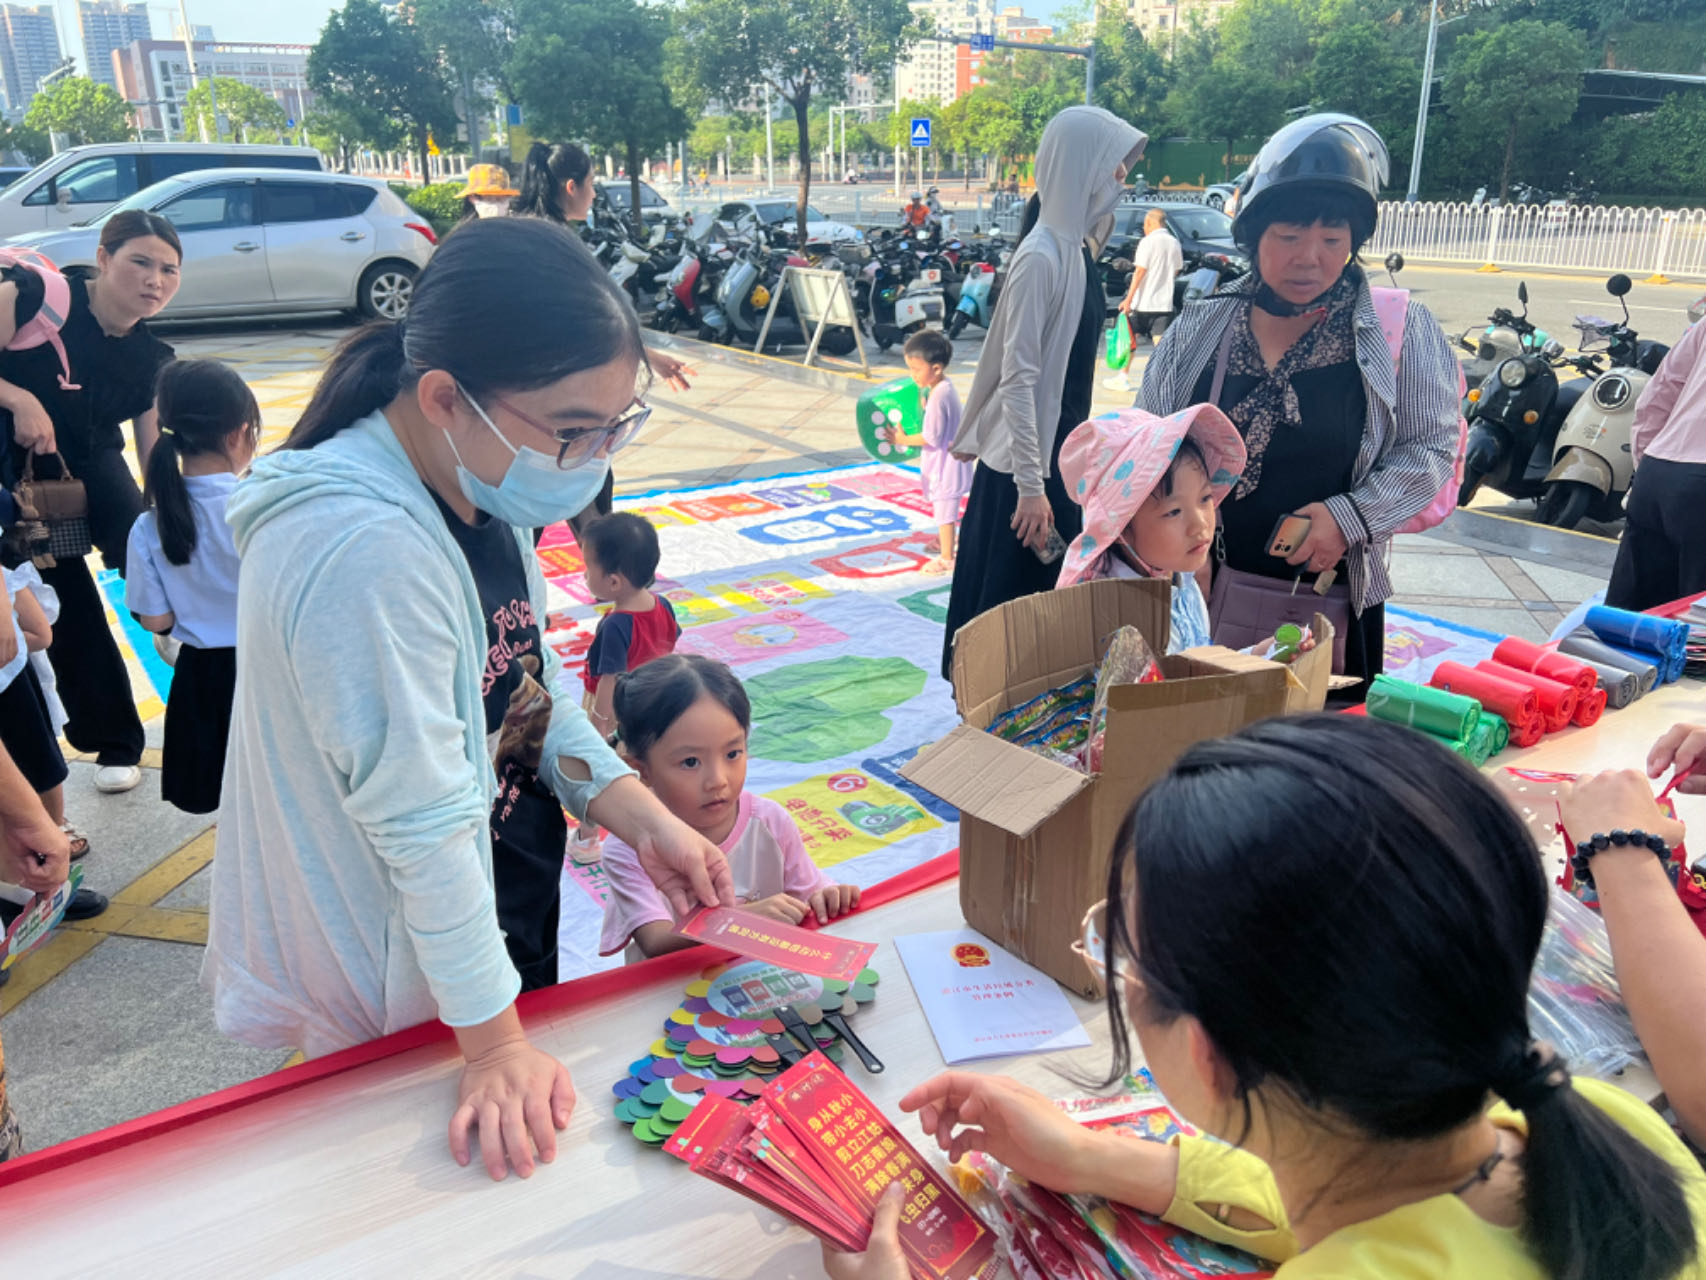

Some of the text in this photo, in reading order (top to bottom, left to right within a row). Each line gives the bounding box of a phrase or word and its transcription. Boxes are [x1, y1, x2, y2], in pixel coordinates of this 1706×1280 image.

[834, 776, 864, 791] 6
[817, 1108, 923, 1220] 从小立志除虫
